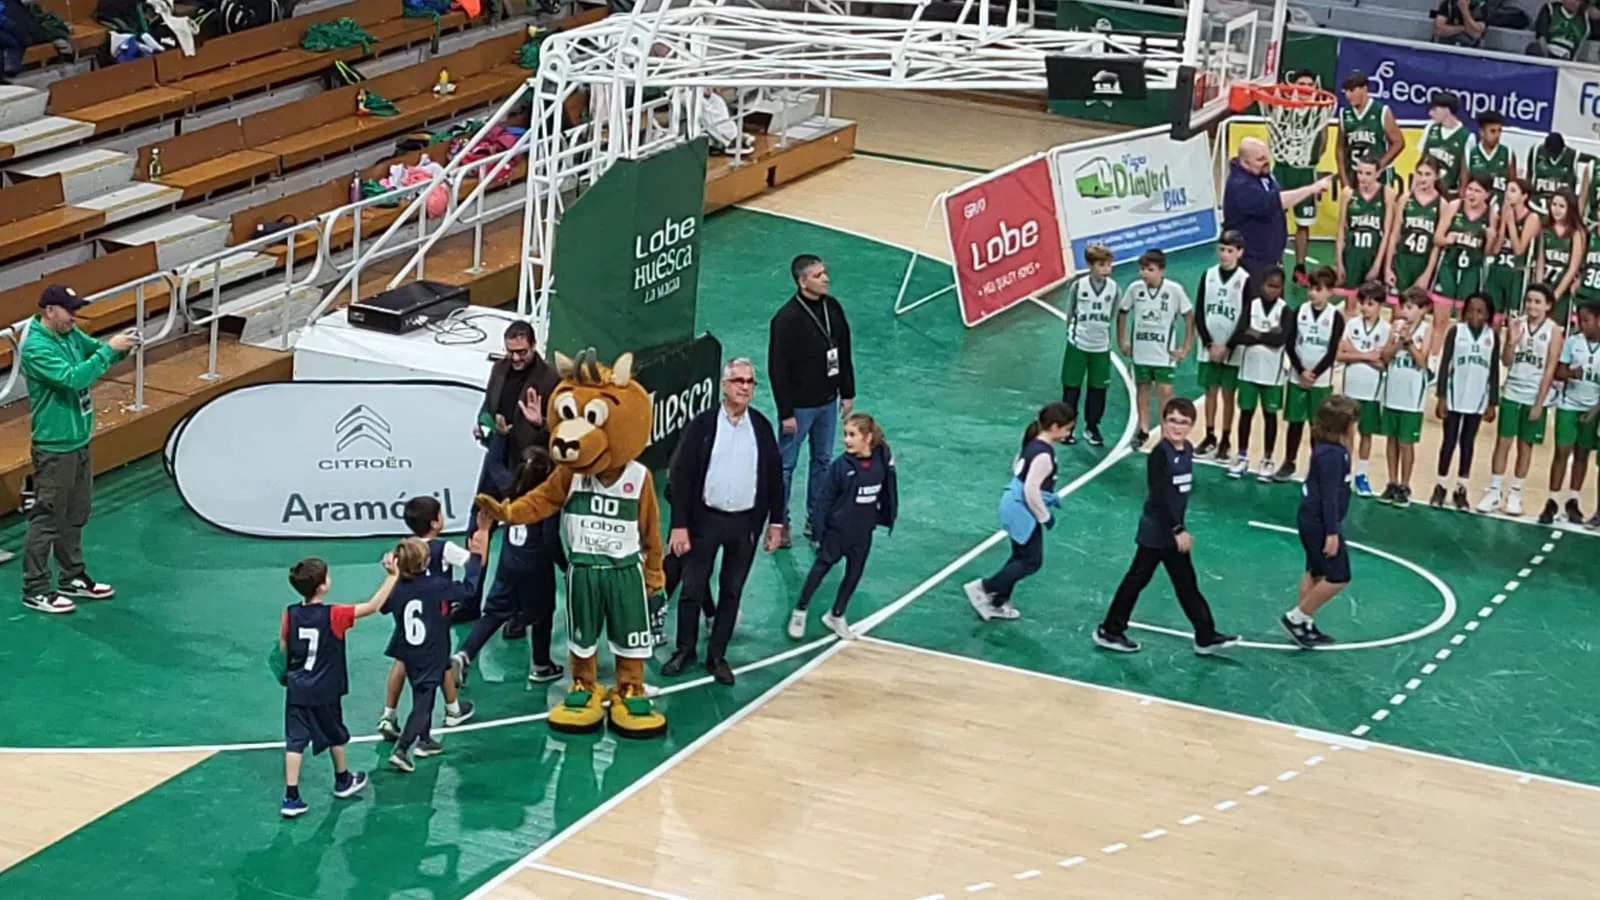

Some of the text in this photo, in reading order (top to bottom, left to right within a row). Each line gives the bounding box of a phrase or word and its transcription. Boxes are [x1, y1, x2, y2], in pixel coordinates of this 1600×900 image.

[636, 216, 695, 259] Lobe
[971, 220, 1039, 270] Lobe
[1405, 233, 1429, 253] 48
[1458, 250, 1470, 268] 6
[281, 488, 457, 524] Aramól
[591, 495, 619, 516] 00
[403, 599, 426, 647] 6
[298, 627, 320, 672] 7
